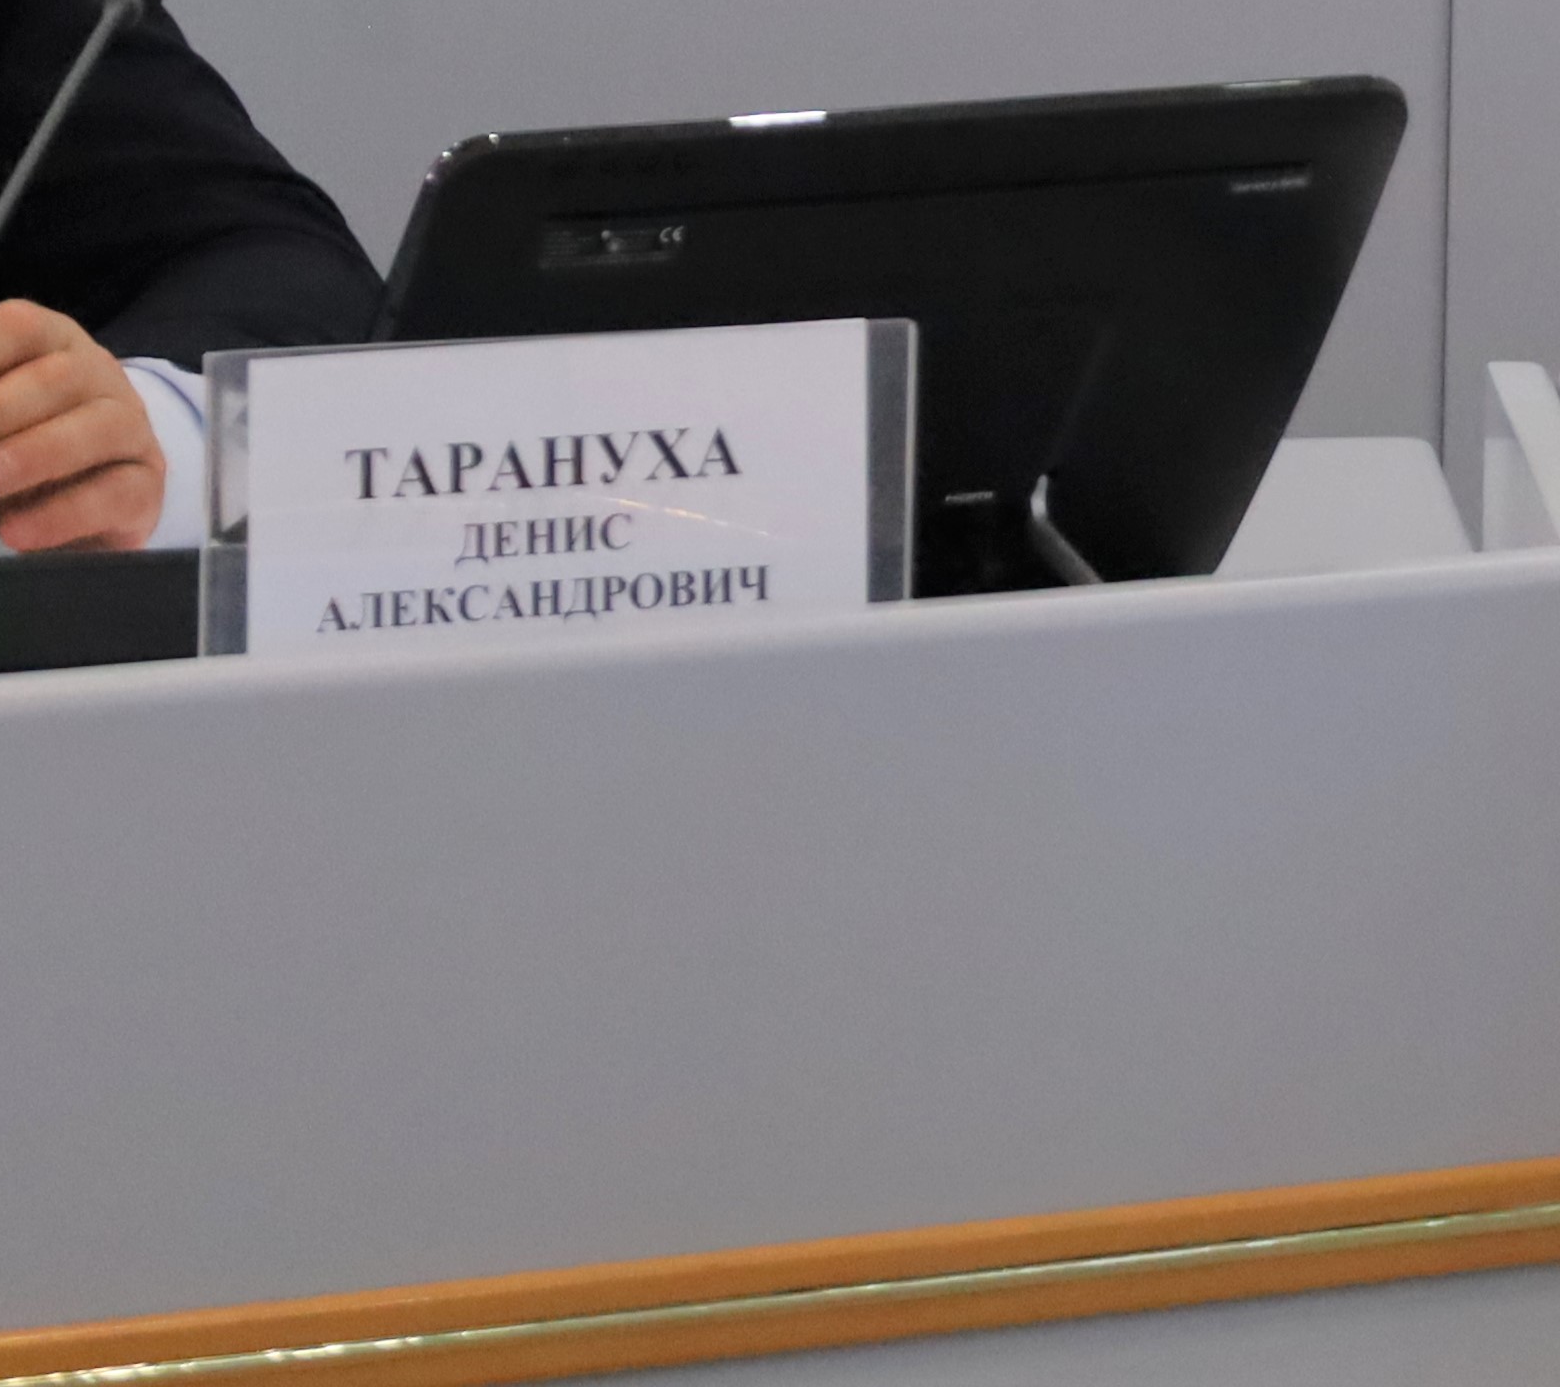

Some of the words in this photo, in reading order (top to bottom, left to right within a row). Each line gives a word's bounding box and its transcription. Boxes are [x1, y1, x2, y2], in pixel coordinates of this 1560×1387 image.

[344, 426, 742, 500] ТАРАНУХА
[454, 513, 633, 567] ДЕНИС
[316, 565, 770, 633] АЛЕКСАНДРОВИЧ
